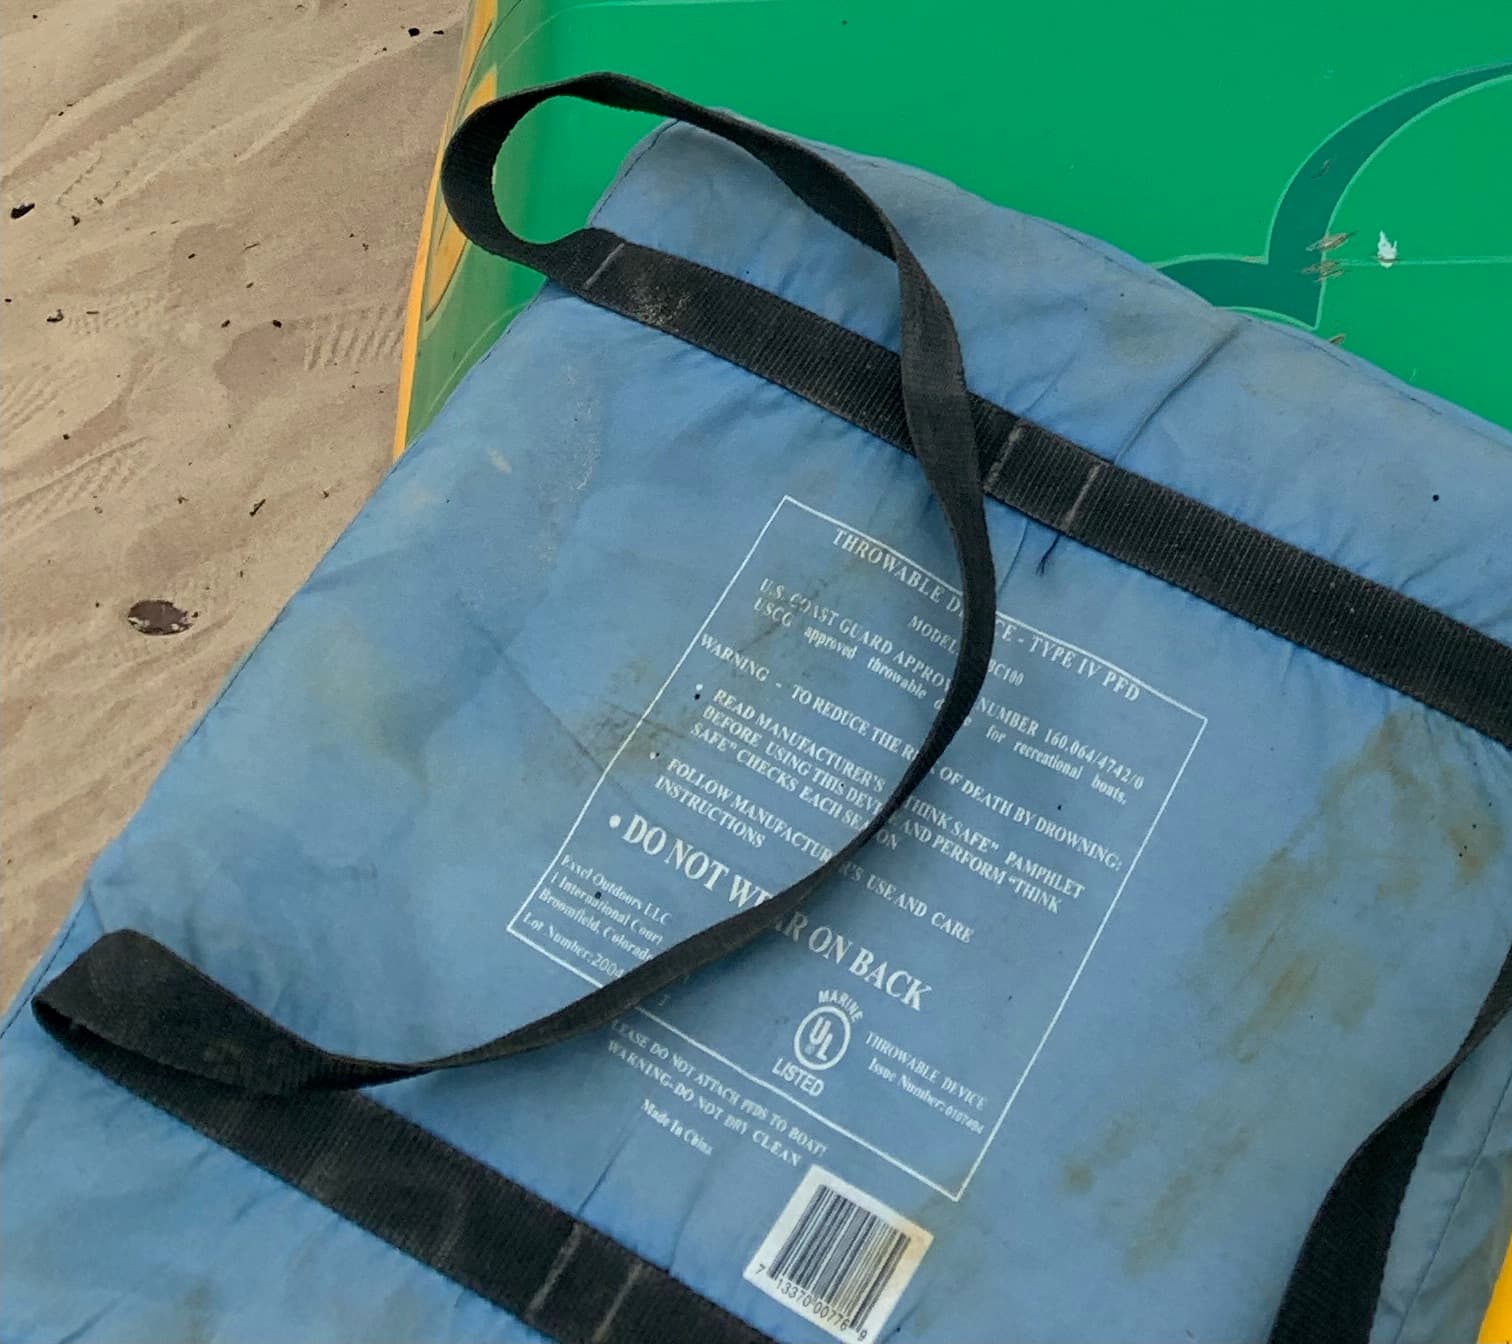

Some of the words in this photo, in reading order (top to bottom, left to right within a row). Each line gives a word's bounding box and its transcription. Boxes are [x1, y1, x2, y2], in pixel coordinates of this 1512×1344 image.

[833, 529, 948, 602] THROWABLE
[1029, 631, 1075, 668] TYPE
[1077, 657, 1101, 677] IV
[1101, 670, 1139, 700] PFD
[908, 615, 960, 657] MODEL:
[753, 597, 791, 627] USCG
[803, 626, 857, 659] approved
[866, 656, 926, 698] throwable
[985, 724, 1006, 743] for
[1013, 741, 1083, 779] recreational
[759, 577, 790, 600] U.S.
[789, 592, 839, 625] COAST
[839, 618, 893, 654] GUARD
[893, 651, 951, 692] APPROV
[973, 692, 1038, 736] NUMBER
[701, 633, 769, 681] WARNING
[791, 684, 812, 704] TO
[812, 696, 869, 735] REDUCE
[870, 726, 902, 752] THE
[938, 766, 963, 784] OF
[961, 779, 1013, 816] DEATH
[1012, 806, 1035, 825] BY
[1034, 816, 1121, 870] DROWNING:
[655, 775, 765, 847] INSTRUCTIONS
[702, 705, 762, 746] BEFORE
[765, 740, 811, 775] USING
[811, 767, 843, 795] THIS
[903, 819, 932, 842] AND
[931, 834, 1006, 884] PERFORM
[713, 689, 755, 719] READ
[759, 713, 885, 791] MANUFACTURER'S
[1004, 851, 1085, 898] PAMPHLET
[736, 749, 798, 791] CHECKS
[798, 785, 842, 818] EACH
[839, 807, 901, 851] SEAON
[667, 758, 732, 800] FOLLOW
[727, 793, 867, 883] MANUFACTURR'S
[866, 874, 896, 900] USE
[894, 893, 927, 917] AND
[930, 911, 973, 942] CARE
[522, 911, 544, 930] Lot
[538, 888, 600, 933] Broomfield,
[558, 876, 630, 925] International
[630, 918, 663, 945] Court
[592, 873, 642, 909] Outdoors
[643, 902, 670, 924] LLC
[622, 814, 666, 854] DO
[664, 839, 729, 889] NOT
[720, 873, 811, 943] WR
[808, 926, 852, 963] ON
[849, 948, 931, 1010] BACK
[807, 1016, 832, 1060] UL
[818, 989, 863, 1021] MARINE
[611, 1018, 649, 1048] LEASE
[649, 1041, 669, 1059] DO
[672, 1053, 695, 1077] NOT
[694, 1072, 740, 1105] ATTACH
[769, 1112, 787, 1132] TO
[771, 1057, 824, 1096] LISTED
[865, 1031, 939, 1081] THROWABLE
[941, 1076, 984, 1109] DEVICE
[867, 1057, 896, 1081] Issue
[641, 1098, 670, 1126] Made
[669, 1119, 683, 1136] In
[683, 1128, 712, 1155] China
[698, 1095, 723, 1119] NOT
[723, 1114, 748, 1134] DRY
[752, 1129, 801, 1166] CLEAN
